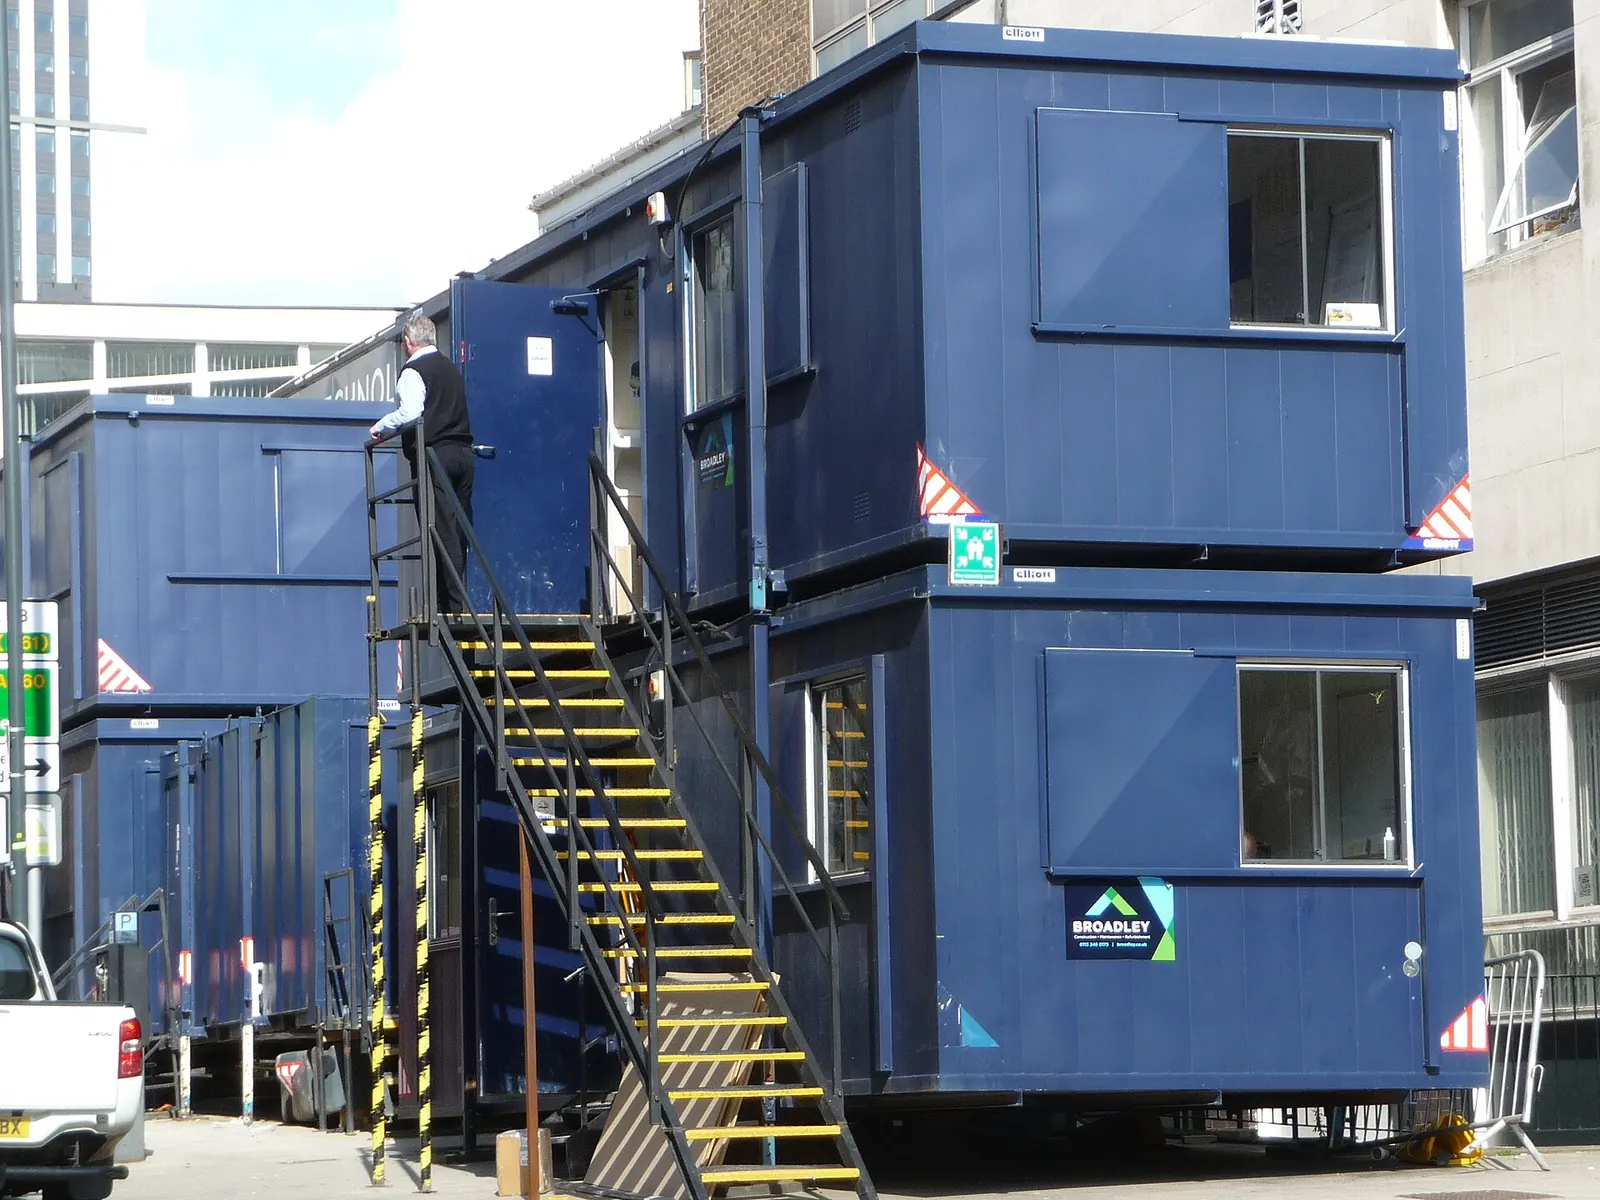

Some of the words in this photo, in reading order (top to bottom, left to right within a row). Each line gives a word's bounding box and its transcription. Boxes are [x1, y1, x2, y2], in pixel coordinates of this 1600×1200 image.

[700, 452, 726, 470] BROADLEY
[0, 634, 50, 652] (61)
[0, 674, 46, 689] A60
[121, 914, 131, 929] P
[1072, 920, 1151, 933] BROADLEY
